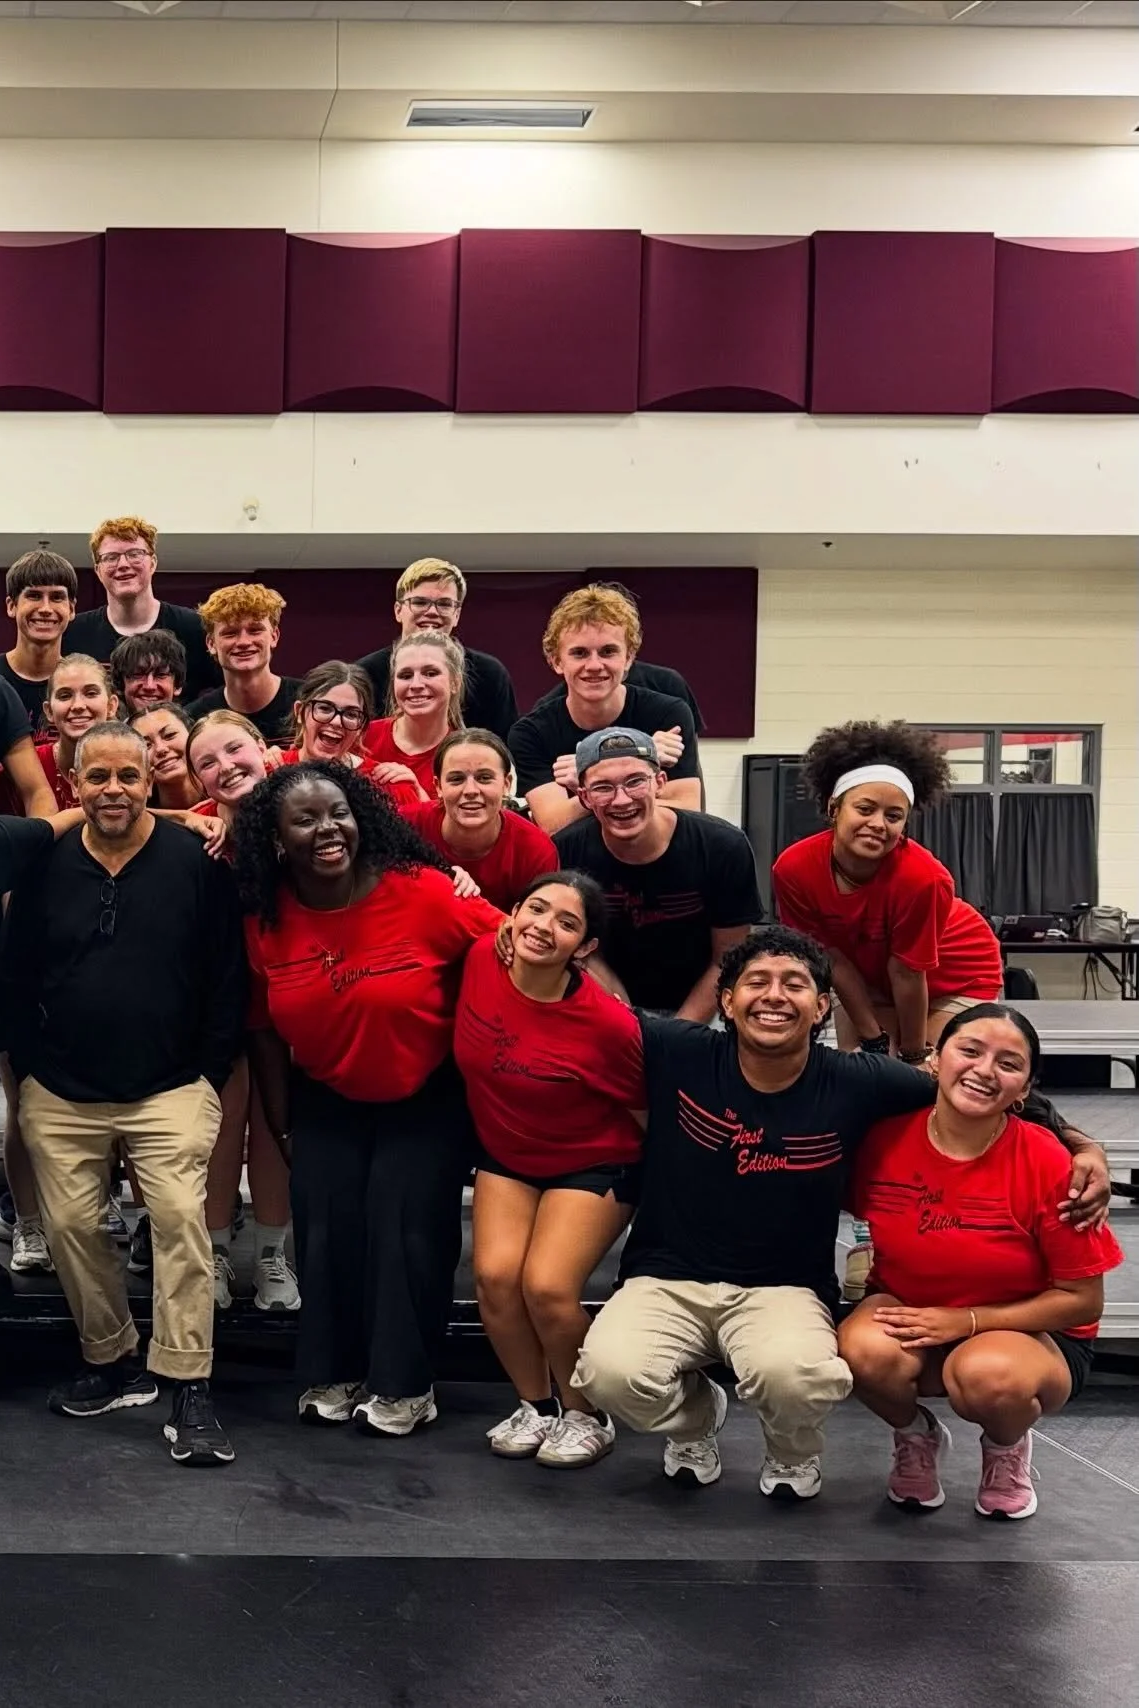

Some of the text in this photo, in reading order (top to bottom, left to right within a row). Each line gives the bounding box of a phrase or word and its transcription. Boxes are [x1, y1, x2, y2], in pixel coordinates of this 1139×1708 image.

[329, 965, 374, 993] Edition
[725, 1108, 738, 1120] The
[730, 1123, 765, 1150] First
[736, 1149, 789, 1176] Edition
[916, 1185, 945, 1208] First
[917, 1208, 962, 1235] Edition
